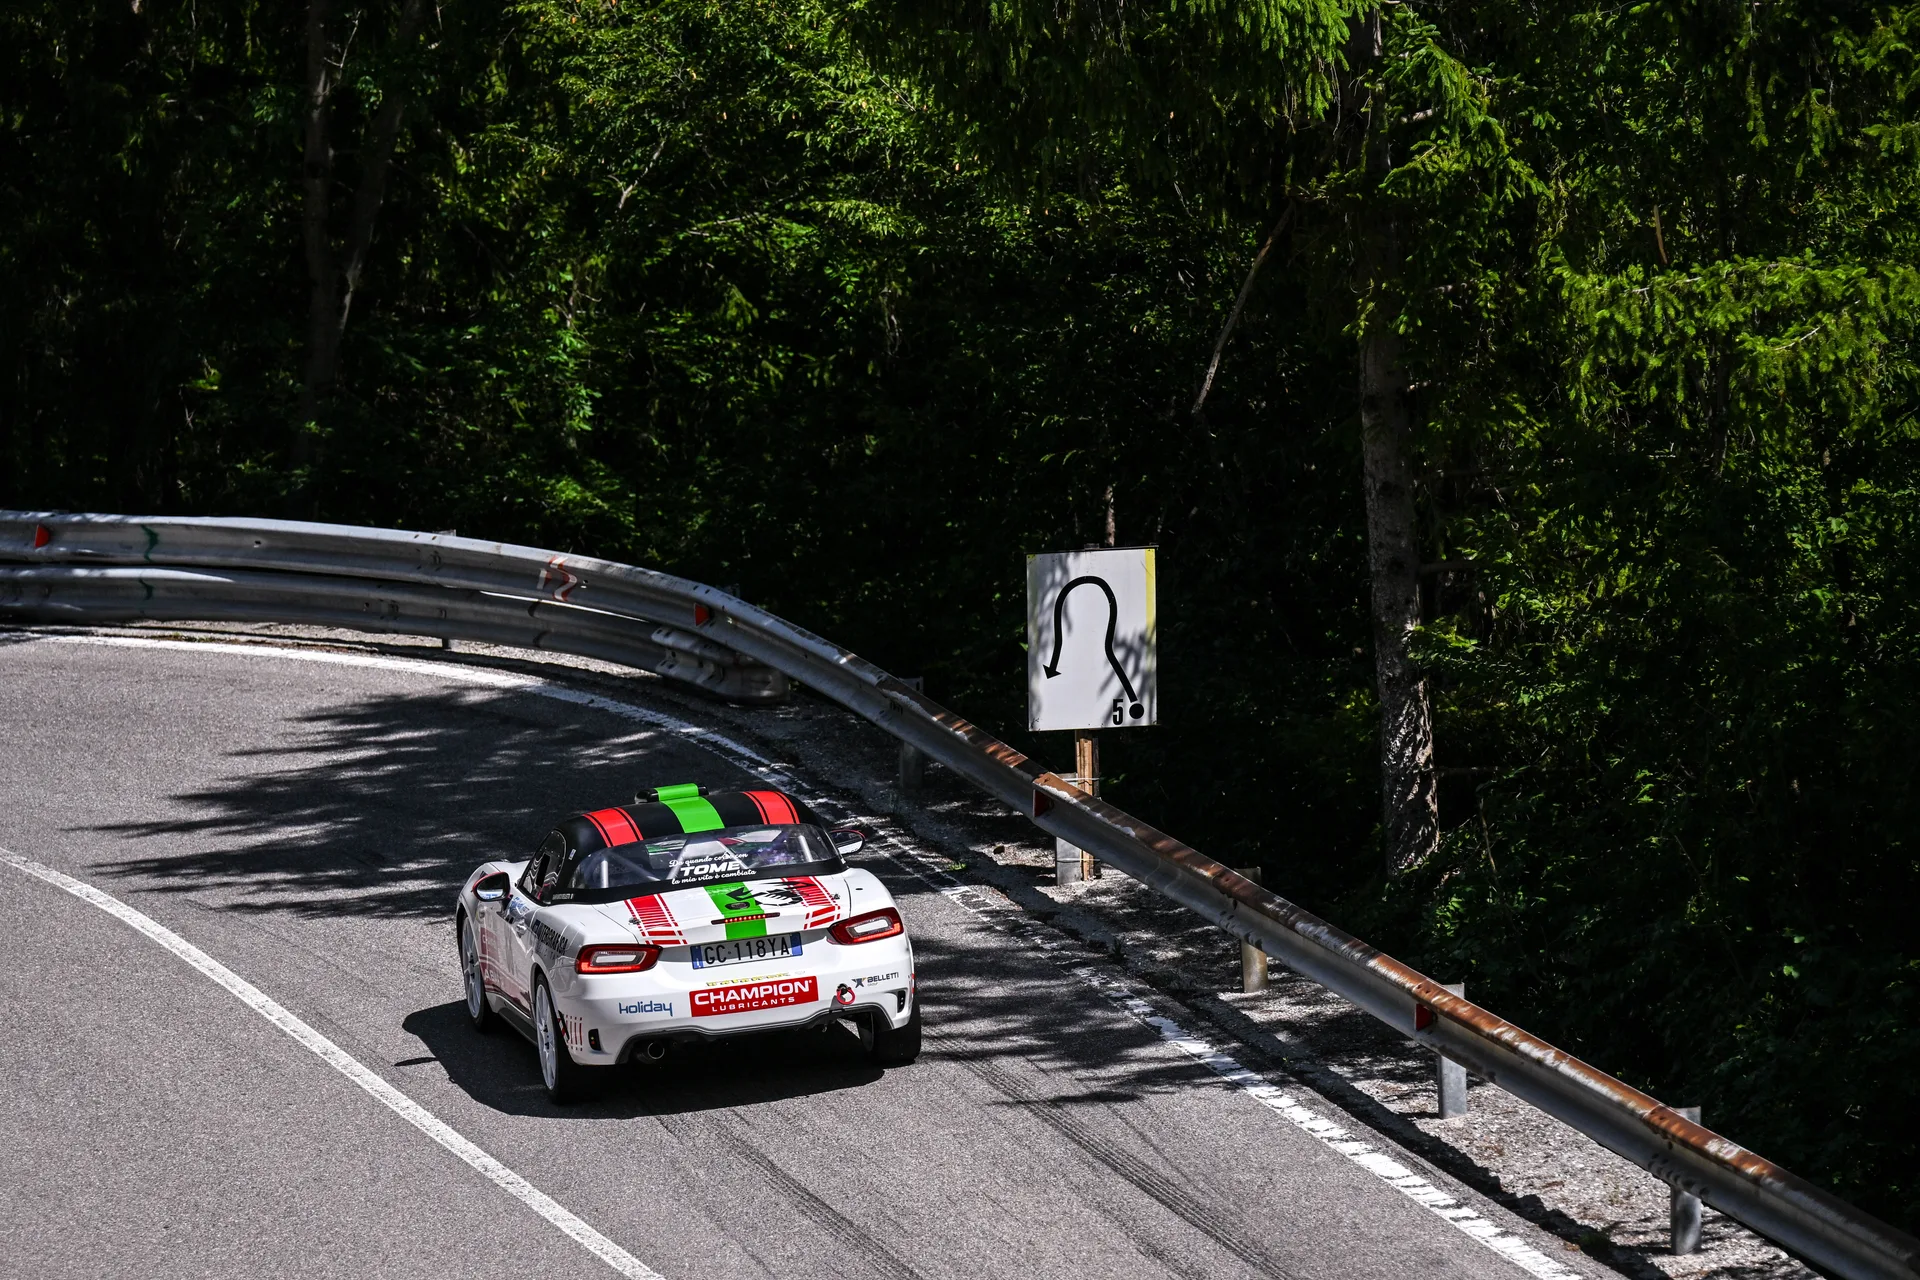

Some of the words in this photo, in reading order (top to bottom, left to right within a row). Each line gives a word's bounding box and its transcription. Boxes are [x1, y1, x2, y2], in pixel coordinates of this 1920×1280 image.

[1112, 698, 1124, 725] 5
[680, 860, 740, 877] TOME
[685, 855, 713, 866] quando
[721, 869, 757, 879] cambiata
[867, 971, 900, 983] BELLETTI
[694, 979, 811, 1006] CHAMPION
[618, 1000, 673, 1017] holiday
[711, 996, 796, 1012] LUBRICANTS
